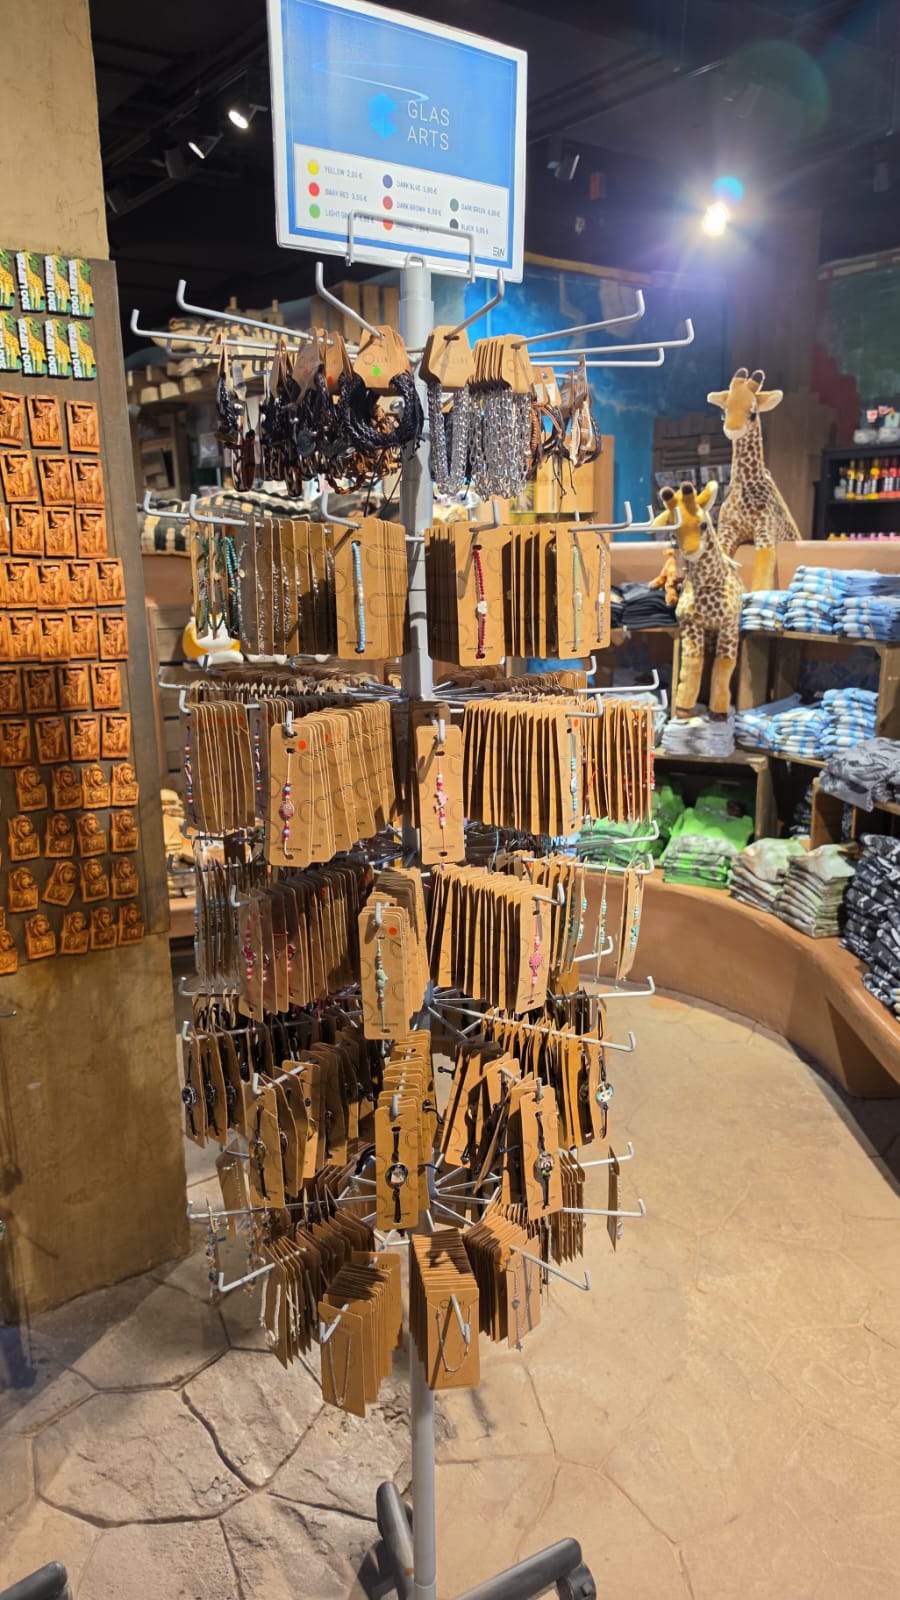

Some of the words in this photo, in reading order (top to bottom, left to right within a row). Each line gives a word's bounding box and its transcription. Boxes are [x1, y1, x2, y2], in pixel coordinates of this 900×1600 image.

[407, 100, 450, 127] GLAS
[407, 125, 449, 151] ARTS
[324, 166, 345, 177] YELLOW
